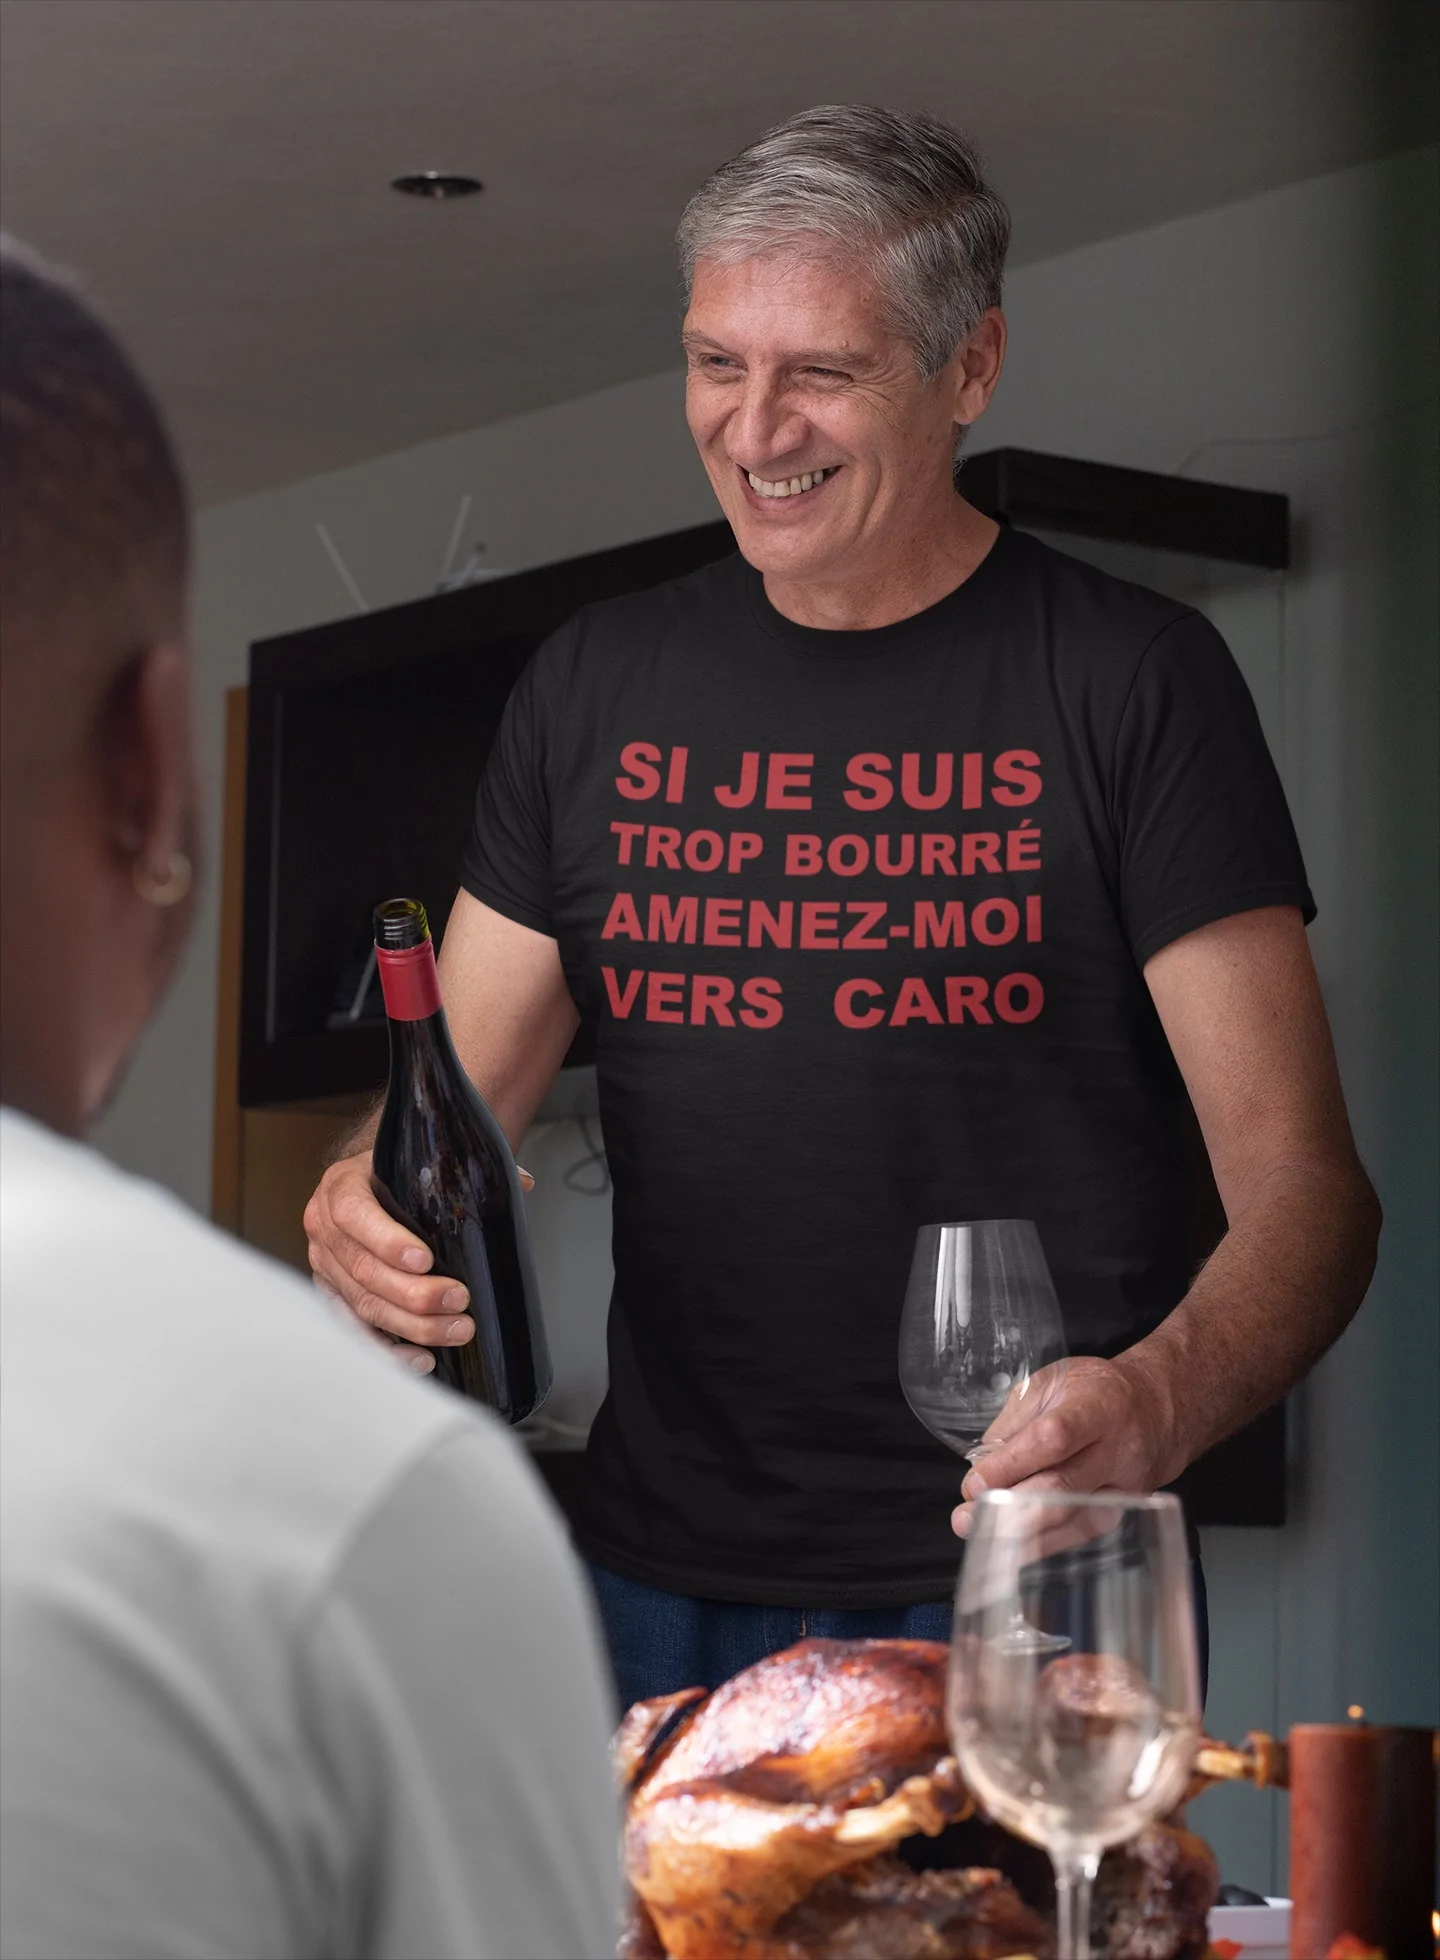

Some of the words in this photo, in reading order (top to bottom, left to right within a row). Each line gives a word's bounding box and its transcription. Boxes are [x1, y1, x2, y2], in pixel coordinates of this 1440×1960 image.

[615, 741, 689, 804] SI
[714, 752, 815, 810] JE
[842, 749, 1043, 812] SUIS
[609, 820, 764, 874] TROP
[784, 818, 1042, 877] BOURRÉ
[600, 892, 1042, 950] AMENEZ-MOI
[600, 966, 784, 1029] VERS
[833, 972, 1044, 1030] CARO
